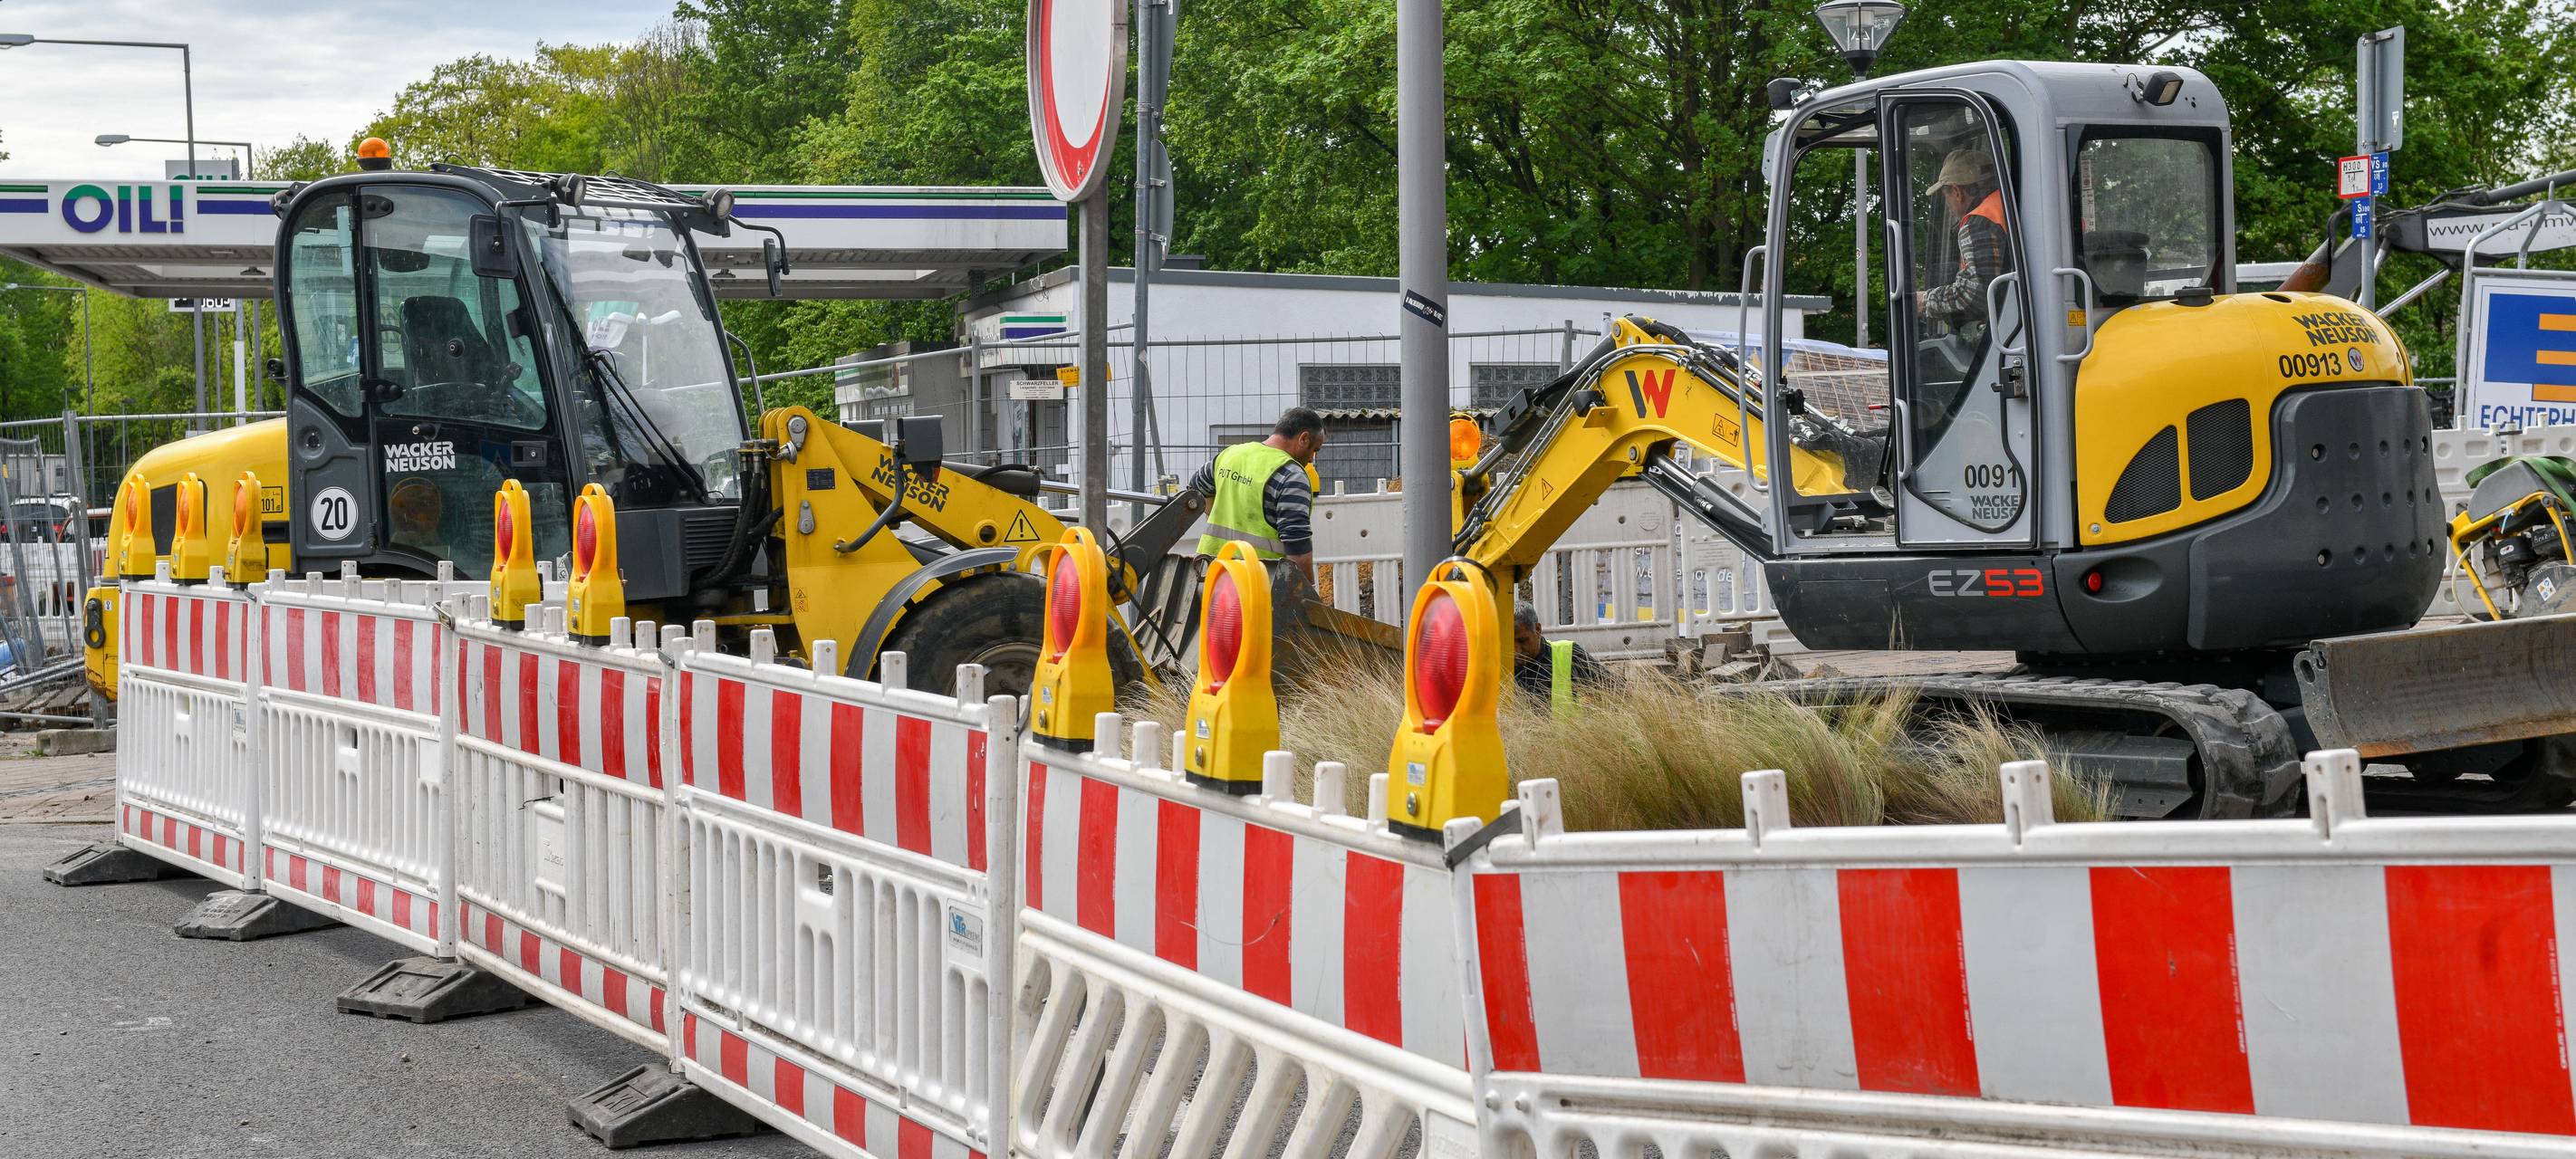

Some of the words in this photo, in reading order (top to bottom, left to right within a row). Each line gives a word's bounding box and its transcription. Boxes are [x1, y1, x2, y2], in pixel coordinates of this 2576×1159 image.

[62, 185, 184, 234] OIL!
[2291, 311, 2371, 329] WACKER
[2305, 327, 2381, 347] NEUSON
[2279, 352, 2342, 378] 00913
[384, 441, 455, 458] WACKER
[386, 455, 456, 473] NEUSON
[879, 454, 950, 500] WCKER
[870, 467, 946, 512] NESON
[1971, 495, 2022, 507] WACKE
[262, 498, 274, 512] 101
[320, 496, 348, 531] 20
[1927, 569, 2044, 597] EZ53
